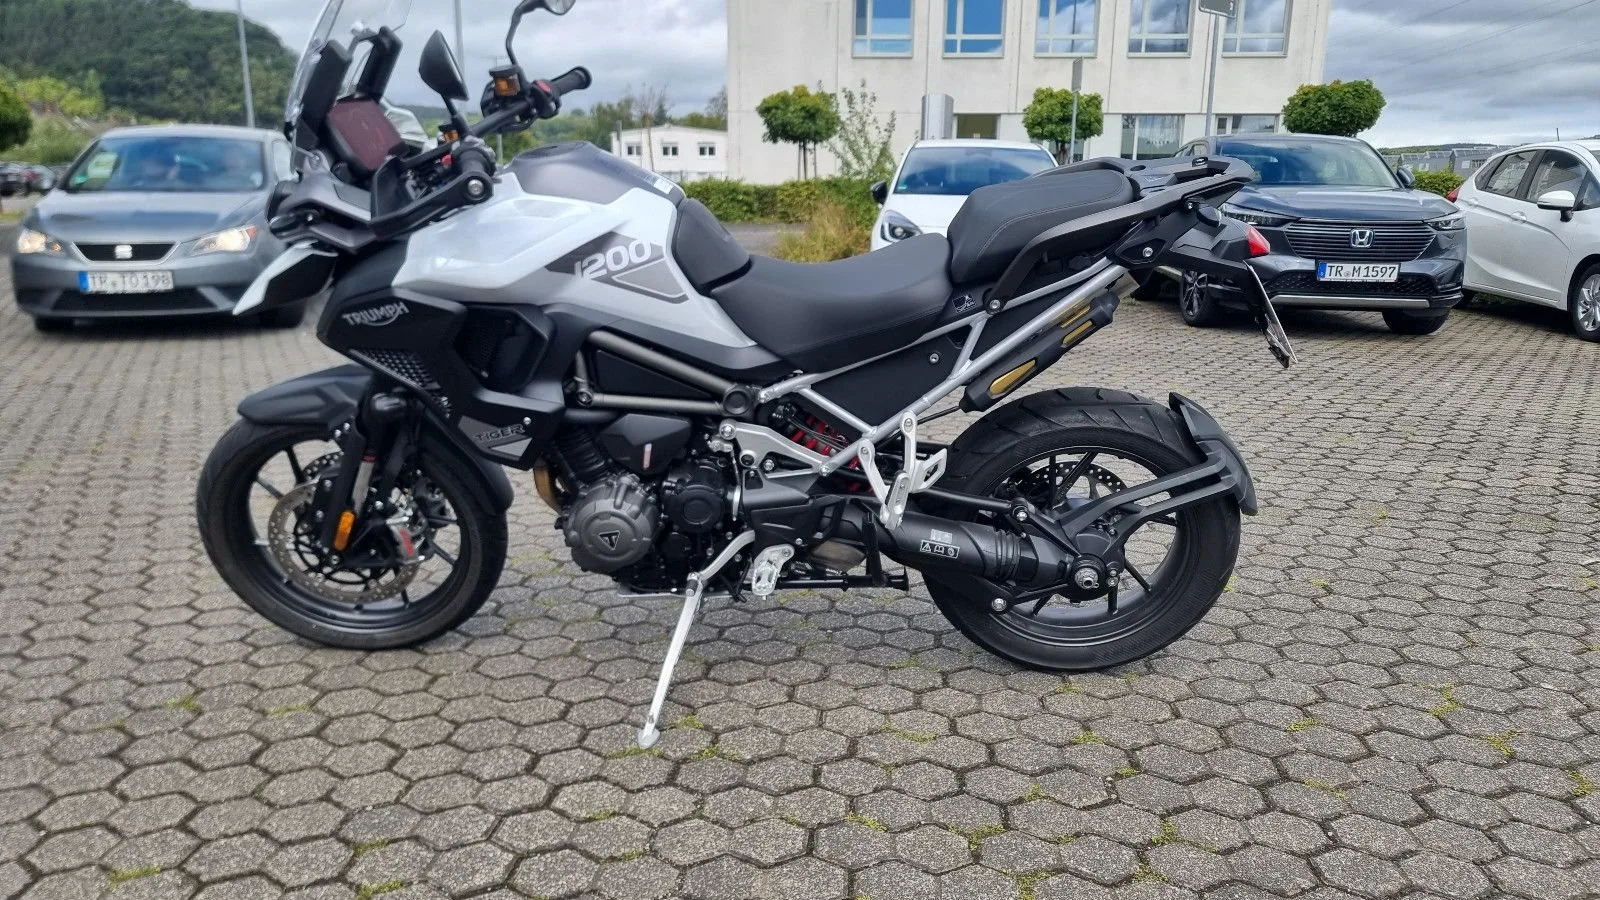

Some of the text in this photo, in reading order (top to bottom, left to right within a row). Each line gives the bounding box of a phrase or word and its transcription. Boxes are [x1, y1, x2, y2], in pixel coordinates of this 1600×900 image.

[574, 239, 652, 280] 1200
[341, 301, 409, 326] TRIUMPH
[474, 423, 526, 442] TIGER
